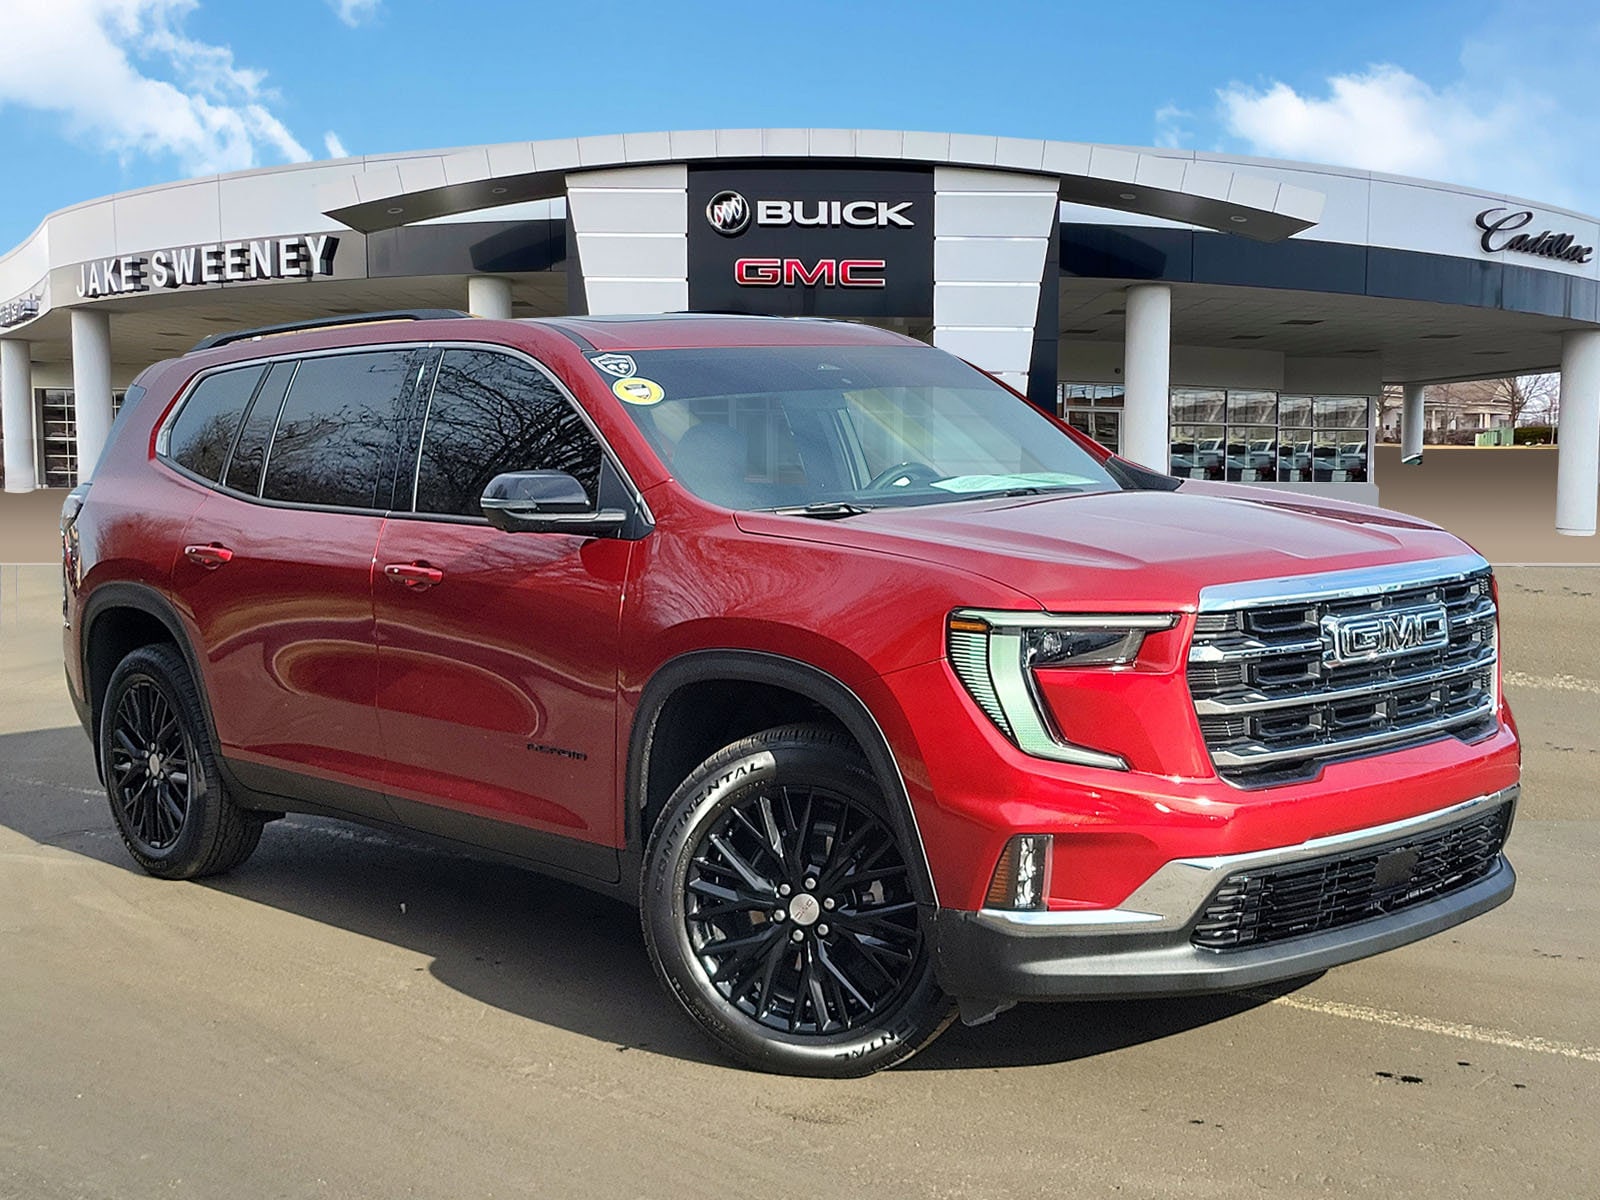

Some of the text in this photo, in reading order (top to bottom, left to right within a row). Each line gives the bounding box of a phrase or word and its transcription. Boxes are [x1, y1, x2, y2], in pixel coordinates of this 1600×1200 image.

[757, 200, 915, 226] BUICK
[1475, 207, 1593, 264] Cadillac
[76, 234, 335, 298] JAKE SWEENEY
[735, 258, 886, 287] GMC
[1343, 610, 1448, 657] GMC
